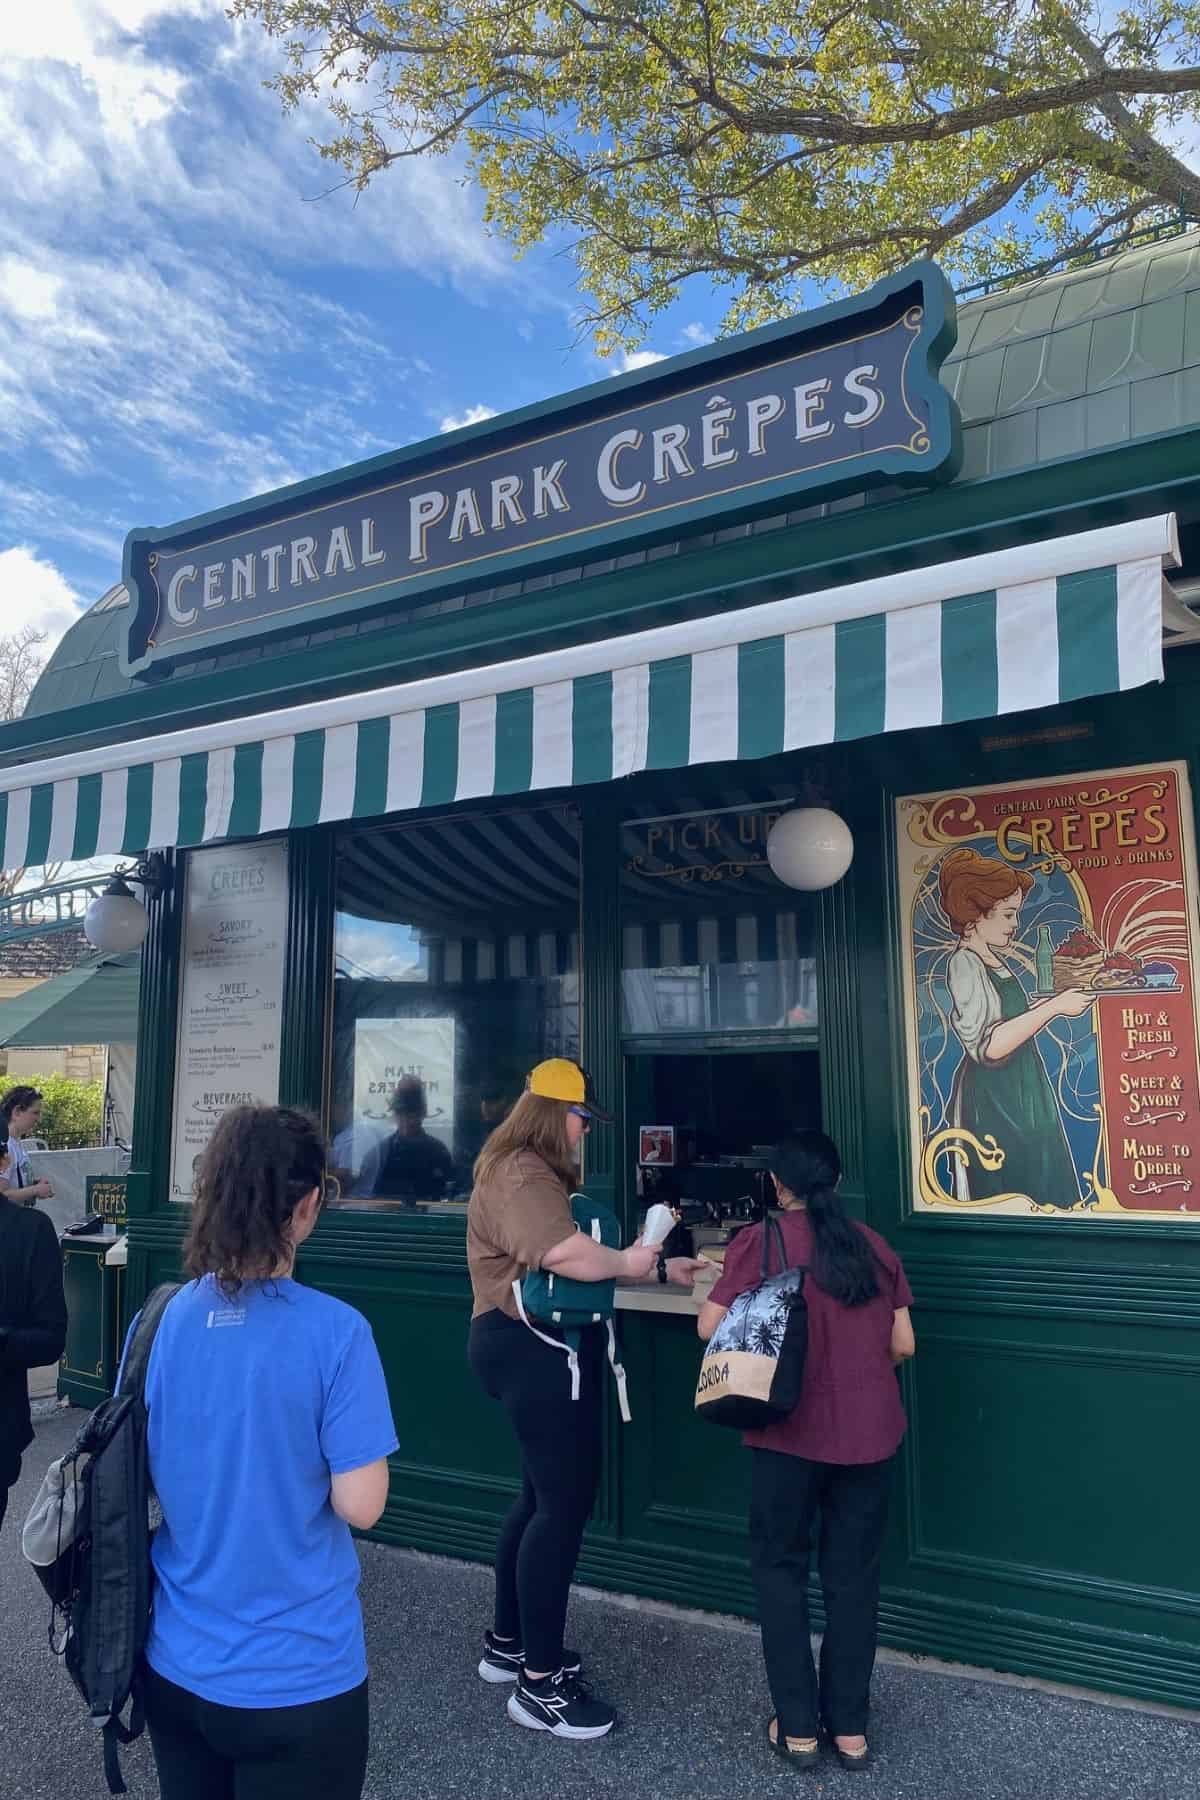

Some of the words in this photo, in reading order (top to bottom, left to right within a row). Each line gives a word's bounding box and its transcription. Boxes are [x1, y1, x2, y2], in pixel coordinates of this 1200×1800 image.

[167, 518, 385, 627] CENTRAL
[409, 459, 571, 563] PARK
[597, 365, 885, 508] CRÊPES
[993, 800, 1043, 815] CENTRAL
[1047, 795, 1078, 809] PARK
[647, 816, 721, 855] PICK
[1077, 855, 1108, 869] FOOD
[1114, 854, 1122, 865] &
[1128, 849, 1175, 864] DRINKS
[1121, 1008, 1151, 1029] HOT
[1157, 1011, 1169, 1026] &
[1127, 1029, 1173, 1049] FRESH
[1120, 1073, 1166, 1094] SWEET
[1170, 1074, 1183, 1091] &
[1130, 1093, 1181, 1114] SAVORY
[1123, 1138, 1165, 1160] MADE
[1172, 1144, 1191, 1157] TO
[1134, 1160, 1183, 1181] ORDER
